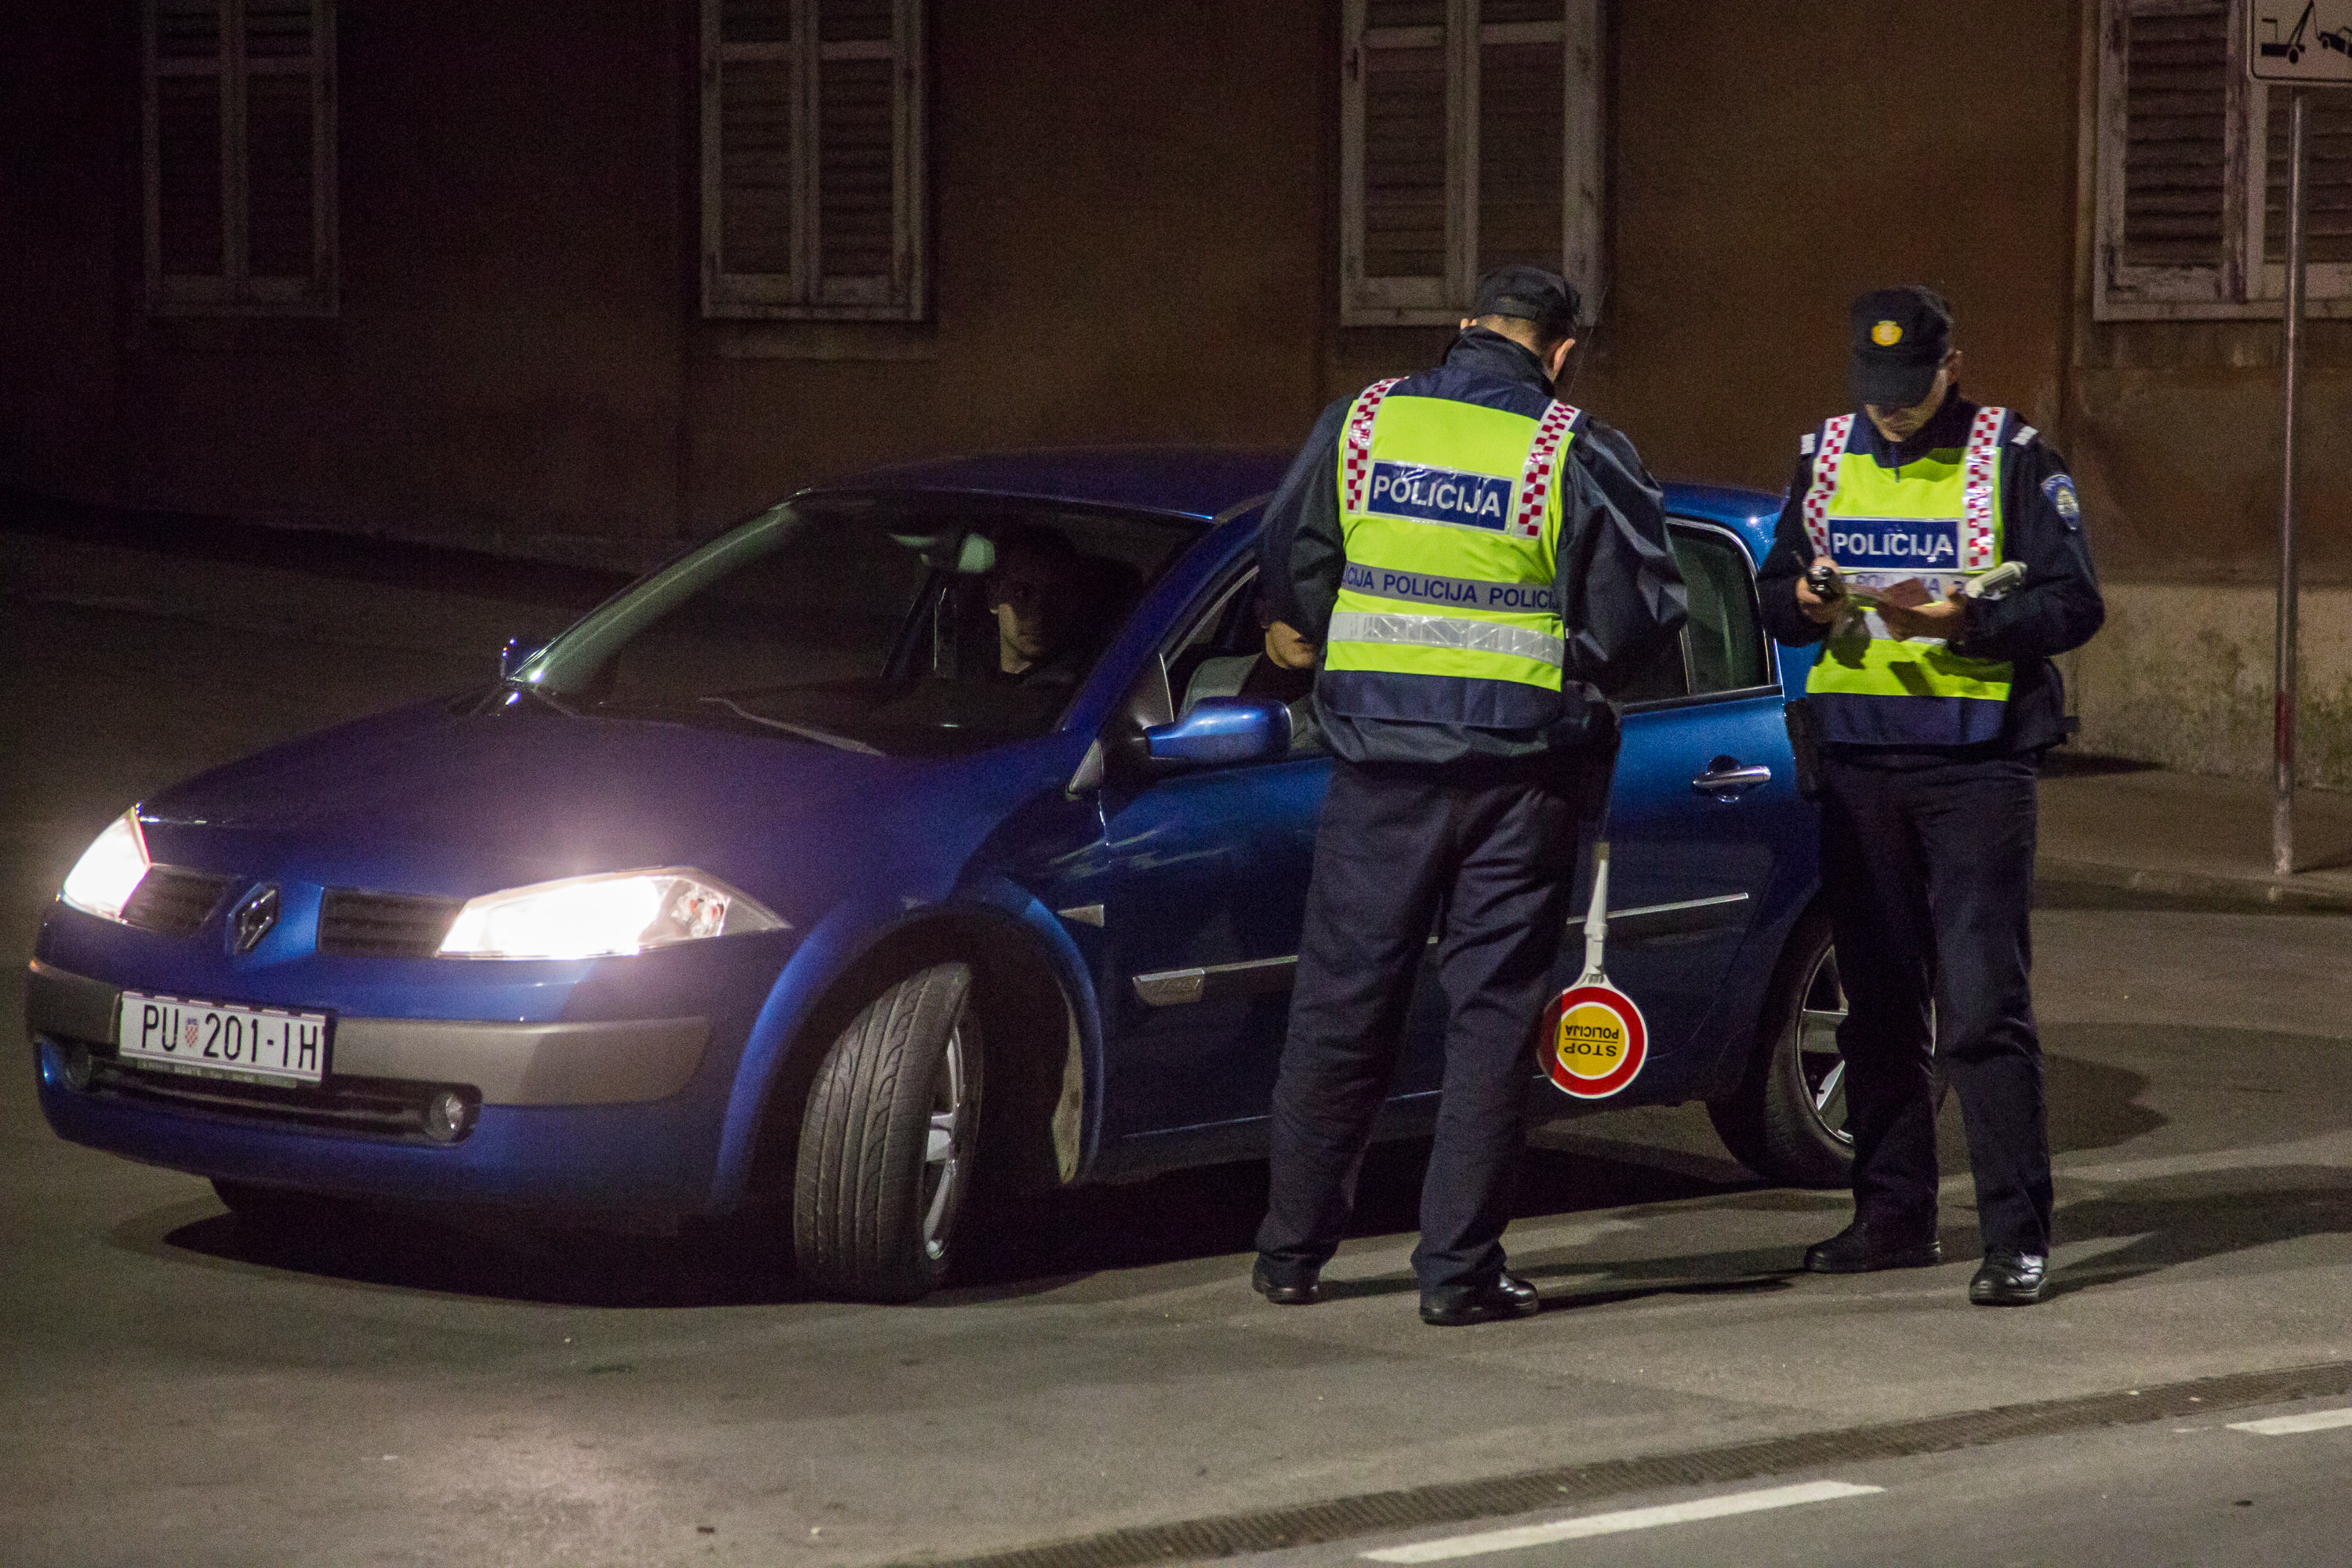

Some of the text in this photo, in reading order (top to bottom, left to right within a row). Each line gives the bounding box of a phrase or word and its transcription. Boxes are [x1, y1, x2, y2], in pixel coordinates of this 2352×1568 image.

[1374, 475, 1501, 517] POLICIJA
[1831, 532, 1955, 557] POLICIJA
[1383, 573, 1477, 603] POLICIJA
[141, 1004, 318, 1071] PU 201-IH
[1565, 1025, 1619, 1040] POLICIJA
[1563, 1043, 1617, 1057] STOP
